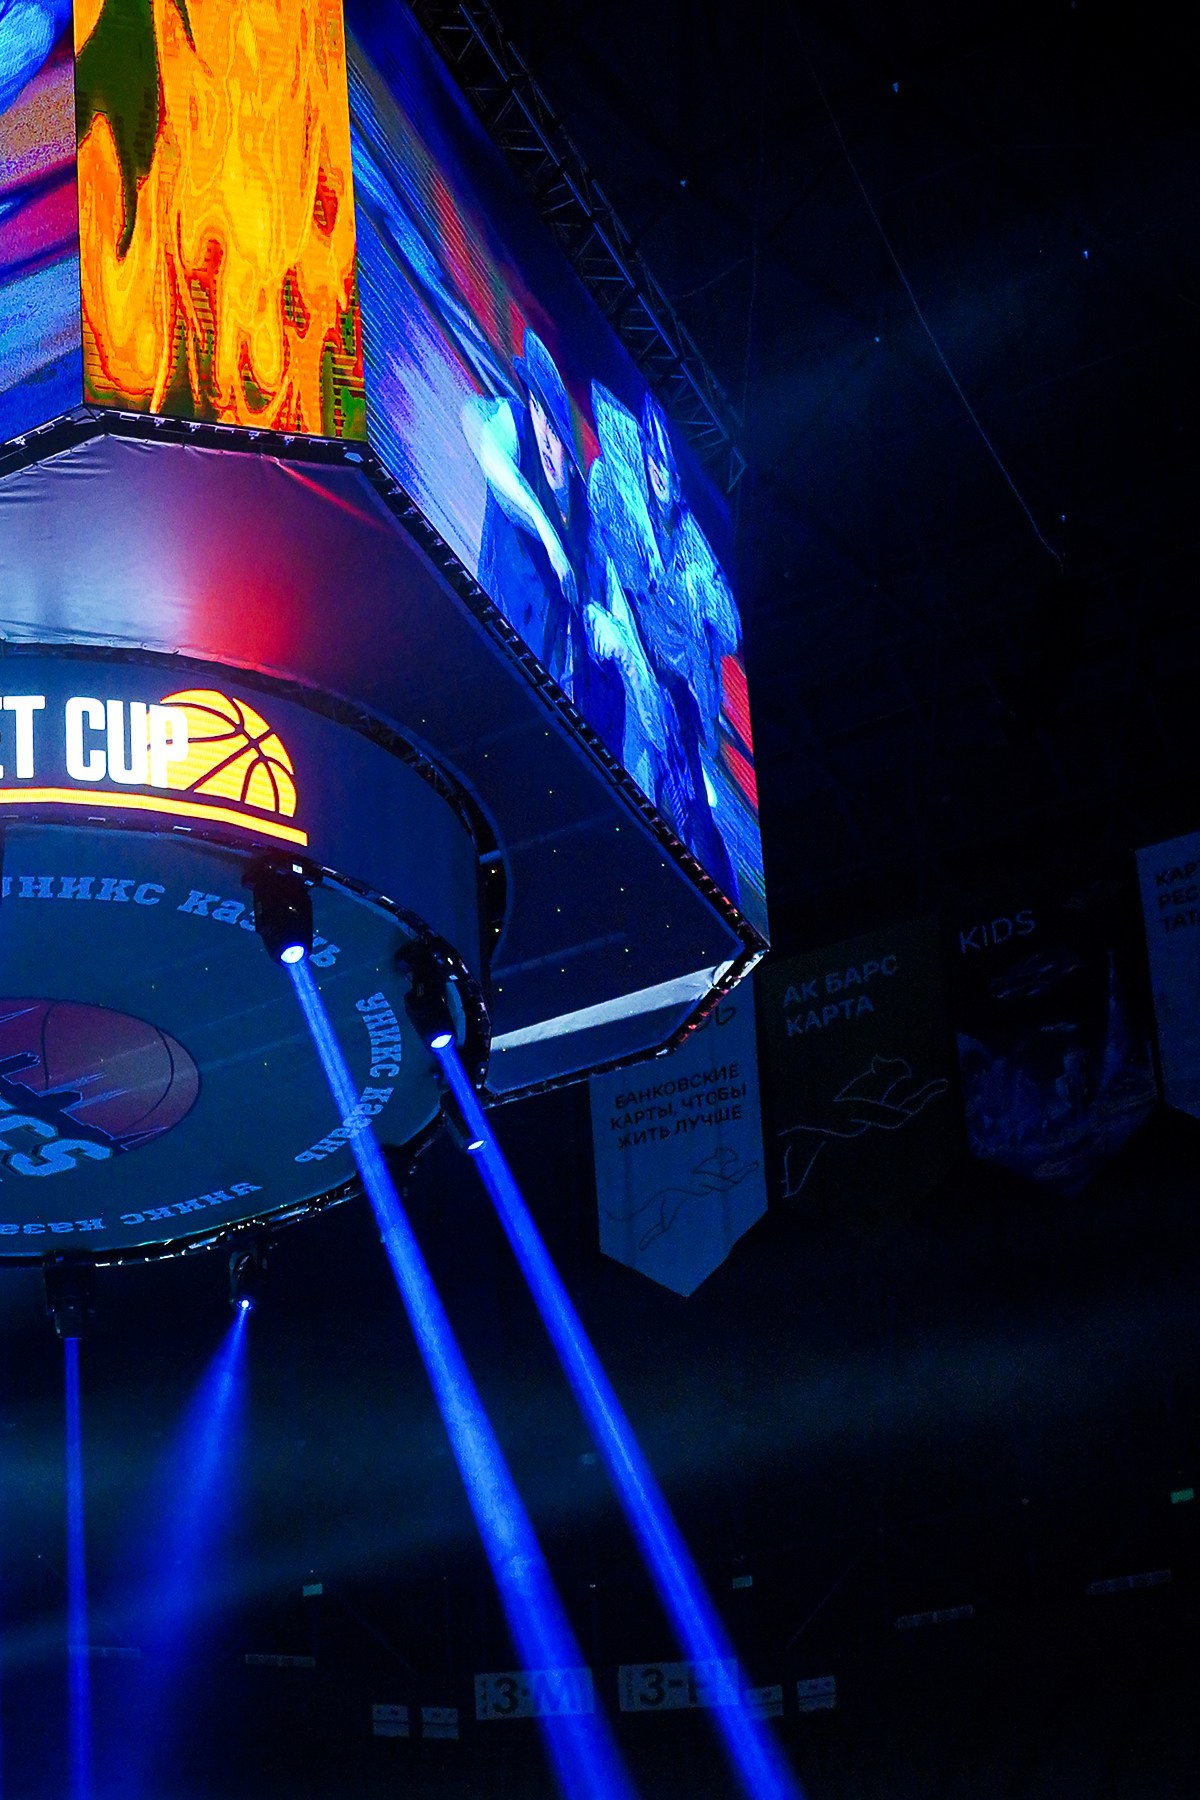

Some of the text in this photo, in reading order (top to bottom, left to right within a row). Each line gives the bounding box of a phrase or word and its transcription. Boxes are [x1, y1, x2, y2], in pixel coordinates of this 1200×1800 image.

[65, 696, 189, 789] CUP
[958, 908, 1038, 955] KIDS
[782, 952, 899, 1009] АК БАРС
[784, 993, 877, 1038] КАРТА
[610, 1083, 747, 1131] КАРТЫ, ЧТОБЫ
[615, 1063, 741, 1110] БАНКОВСКИЕ
[617, 1104, 743, 1151] ЖИТЬ ЛУЧШЕ
